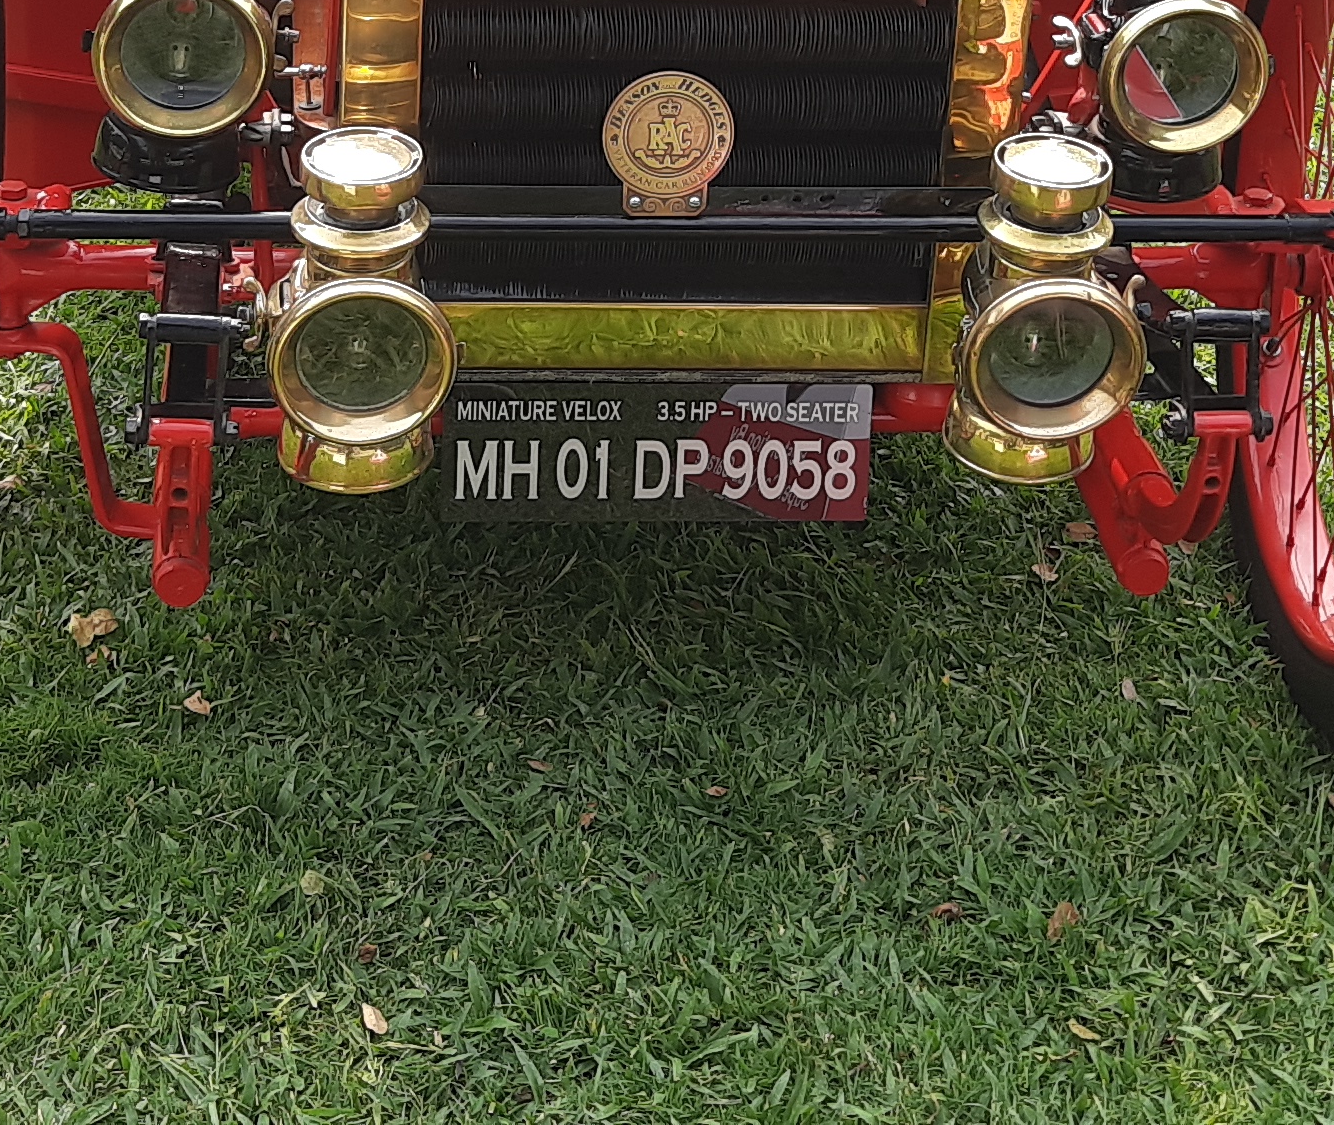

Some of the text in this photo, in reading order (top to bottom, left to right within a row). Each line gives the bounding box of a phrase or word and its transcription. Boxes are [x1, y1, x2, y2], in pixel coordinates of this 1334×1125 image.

[610, 81, 661, 130] BENSON
[678, 78, 727, 131] HEDGES
[648, 117, 692, 154] RAC
[614, 148, 652, 187] VETERAN
[655, 181, 679, 190] CAR
[681, 170, 706, 187] RUN
[457, 400, 557, 421] MINIATURE
[562, 400, 622, 421] VELOX
[657, 401, 686, 421] 3.5
[690, 402, 717, 422] HP
[737, 402, 782, 422] TWO
[786, 403, 859, 423] SEATER
[454, 440, 540, 500] MH
[556, 438, 611, 500] 01
[633, 438, 709, 500] DP
[722, 438, 857, 500] 9058
